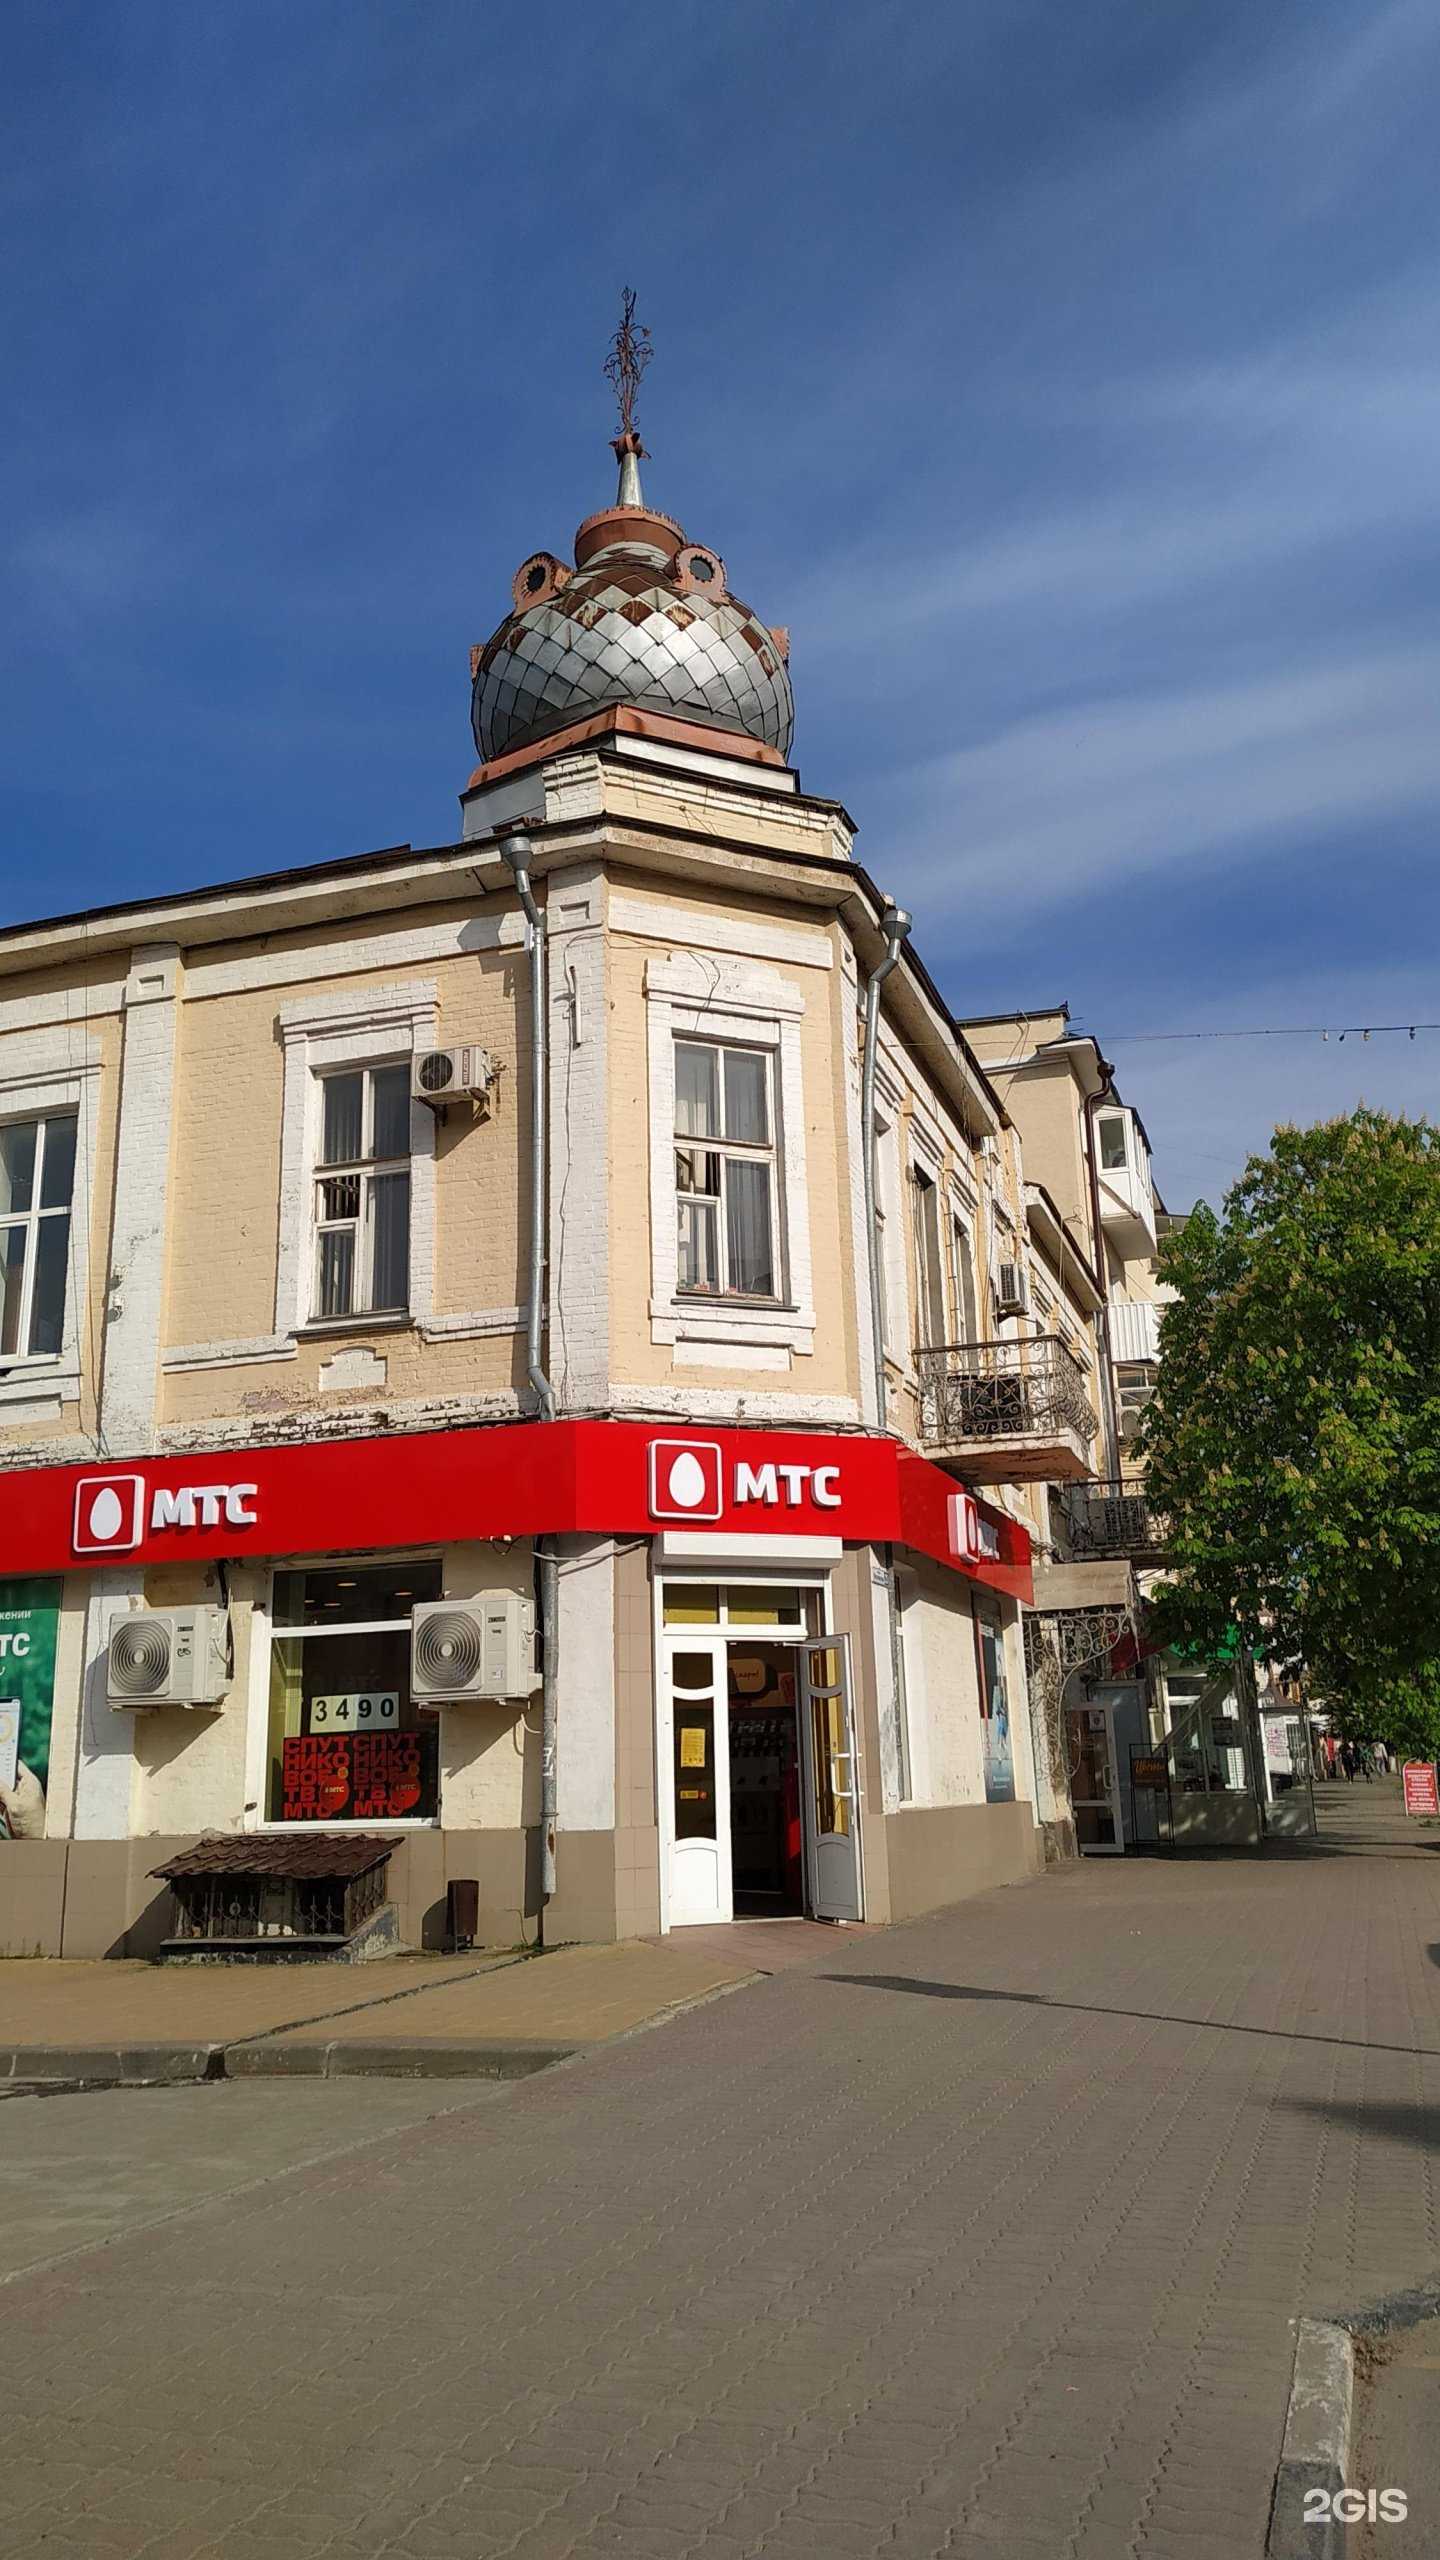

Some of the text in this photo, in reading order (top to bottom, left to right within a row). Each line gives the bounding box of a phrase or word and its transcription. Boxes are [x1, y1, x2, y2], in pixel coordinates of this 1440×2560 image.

[734, 1462, 842, 1506] МТС
[152, 1483, 258, 1528] МТС
[315, 1698, 395, 1722] 3490
[285, 1735, 350, 1753] СПУТ
[353, 1732, 419, 1750] СПУТ
[284, 1752, 350, 1770] НИКО
[354, 1750, 421, 1767] НИКО
[284, 1786, 315, 1802] ТВ
[354, 1784, 386, 1801] ТВ
[284, 1802, 332, 1819] МТС
[354, 1800, 403, 1816] МТС
